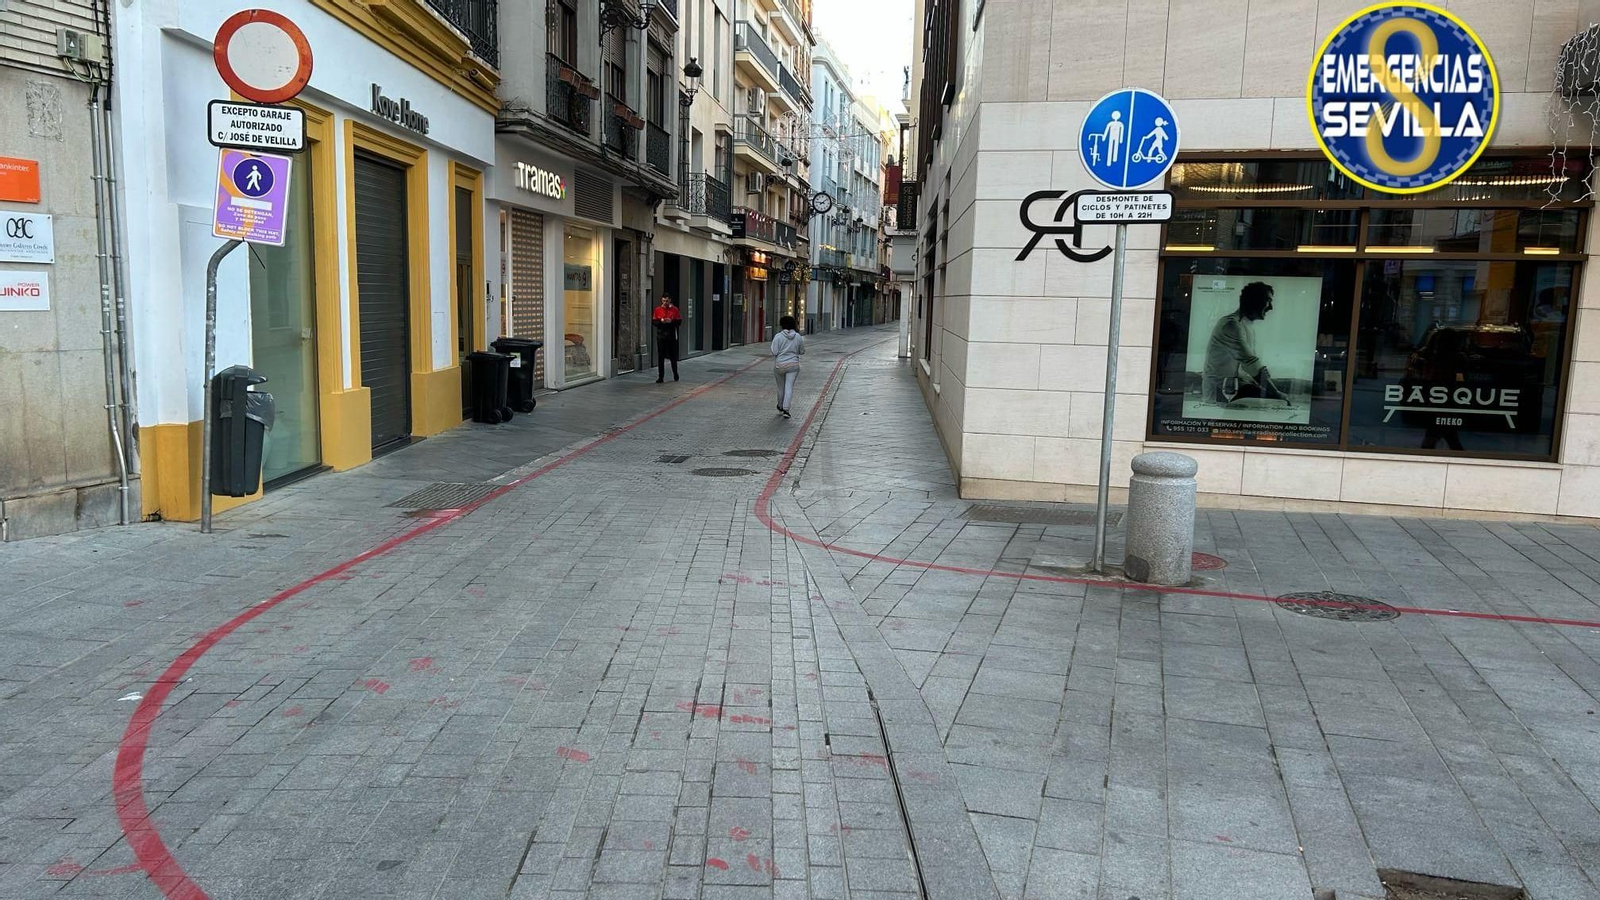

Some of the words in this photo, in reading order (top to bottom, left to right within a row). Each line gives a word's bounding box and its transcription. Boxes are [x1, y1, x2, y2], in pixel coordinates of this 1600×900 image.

[222, 106, 258, 118] EXCEPTO
[260, 110, 292, 120] GARAJE
[370, 83, 400, 122] Kave
[400, 98, 430, 134] Home
[230, 120, 282, 132] AUTORIZADO
[218, 132, 227, 141] C/
[230, 132, 249, 142] JOSÉ
[252, 135, 262, 143] DE
[265, 135, 297, 146] VELILLA
[1436, 417, 1463, 426] ENEKO
